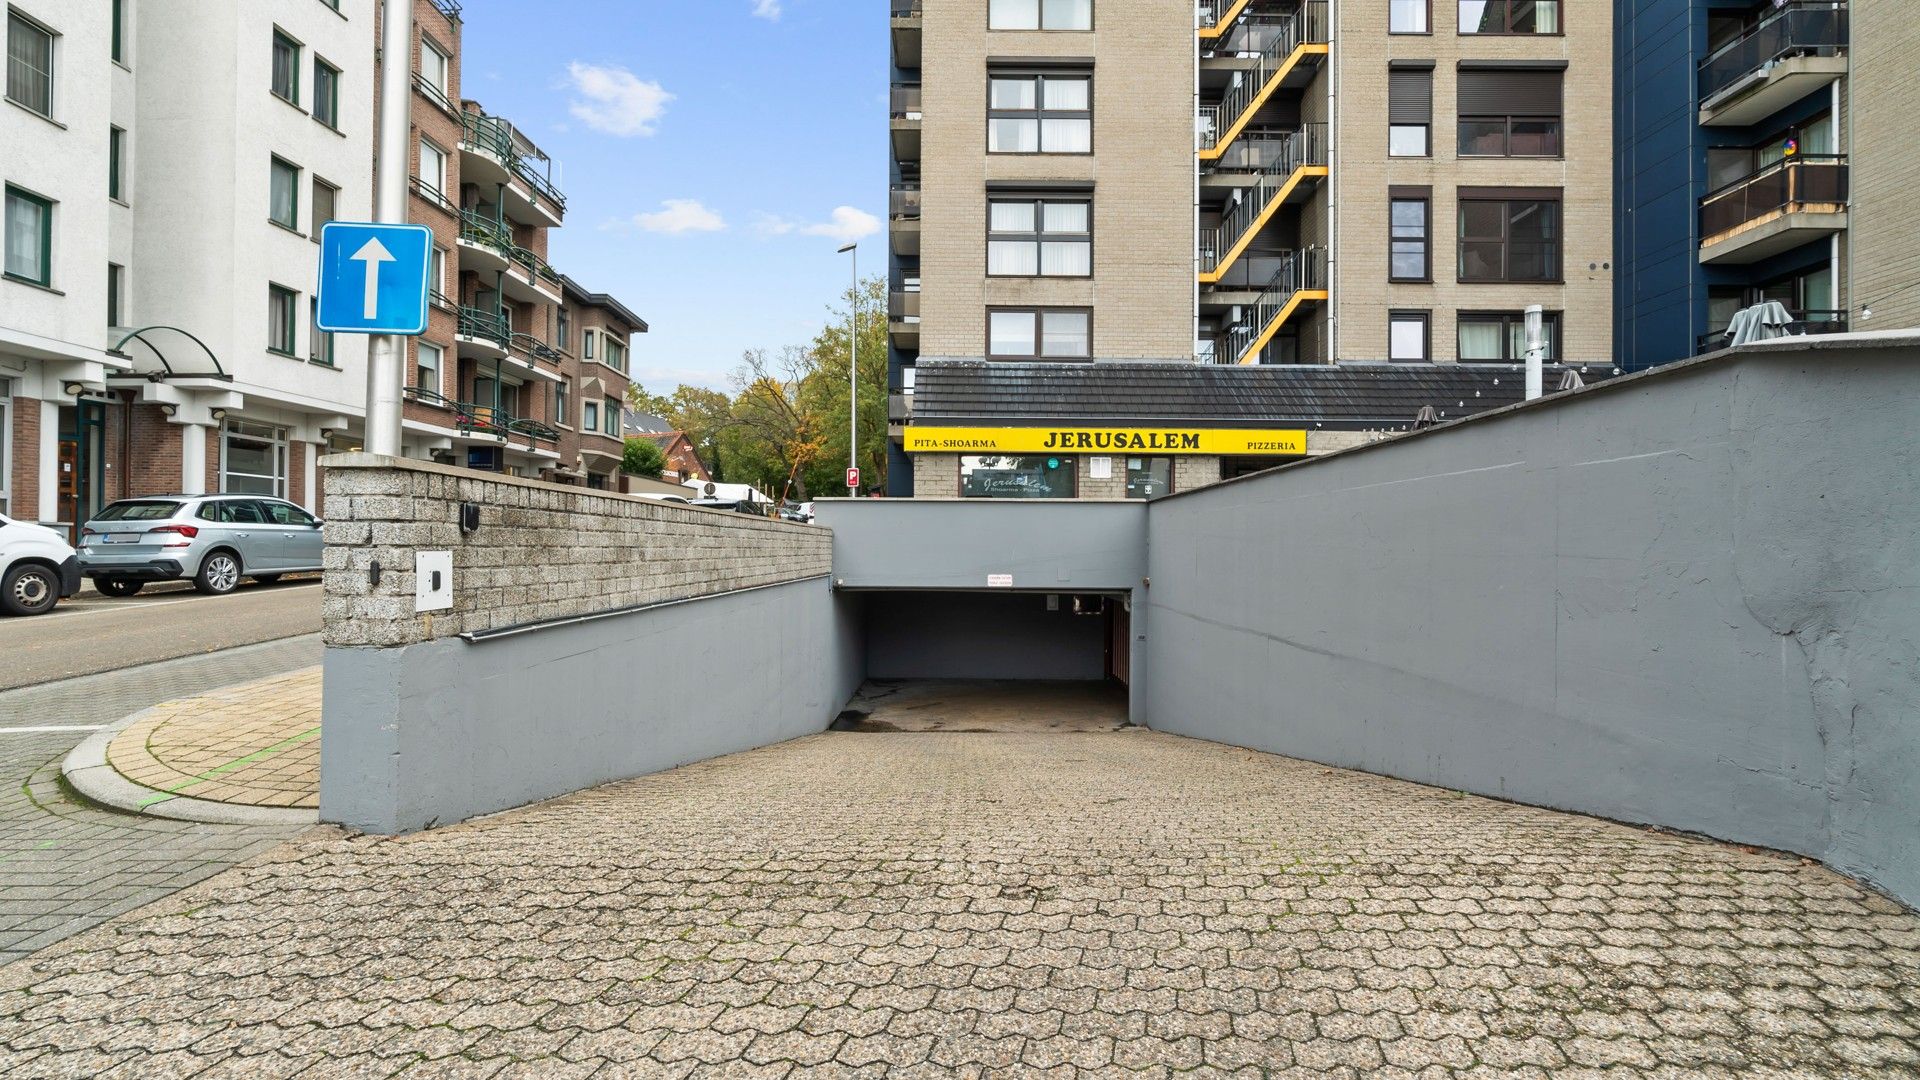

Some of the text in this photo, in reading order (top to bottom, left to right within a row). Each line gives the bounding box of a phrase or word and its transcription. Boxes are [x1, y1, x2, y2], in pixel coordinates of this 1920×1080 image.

[914, 439, 997, 448] PITA-SHOARMA
[1043, 432, 1200, 449] JERUSALEM
[1246, 441, 1296, 450] PIZZERIA
[849, 471, 857, 480] P
